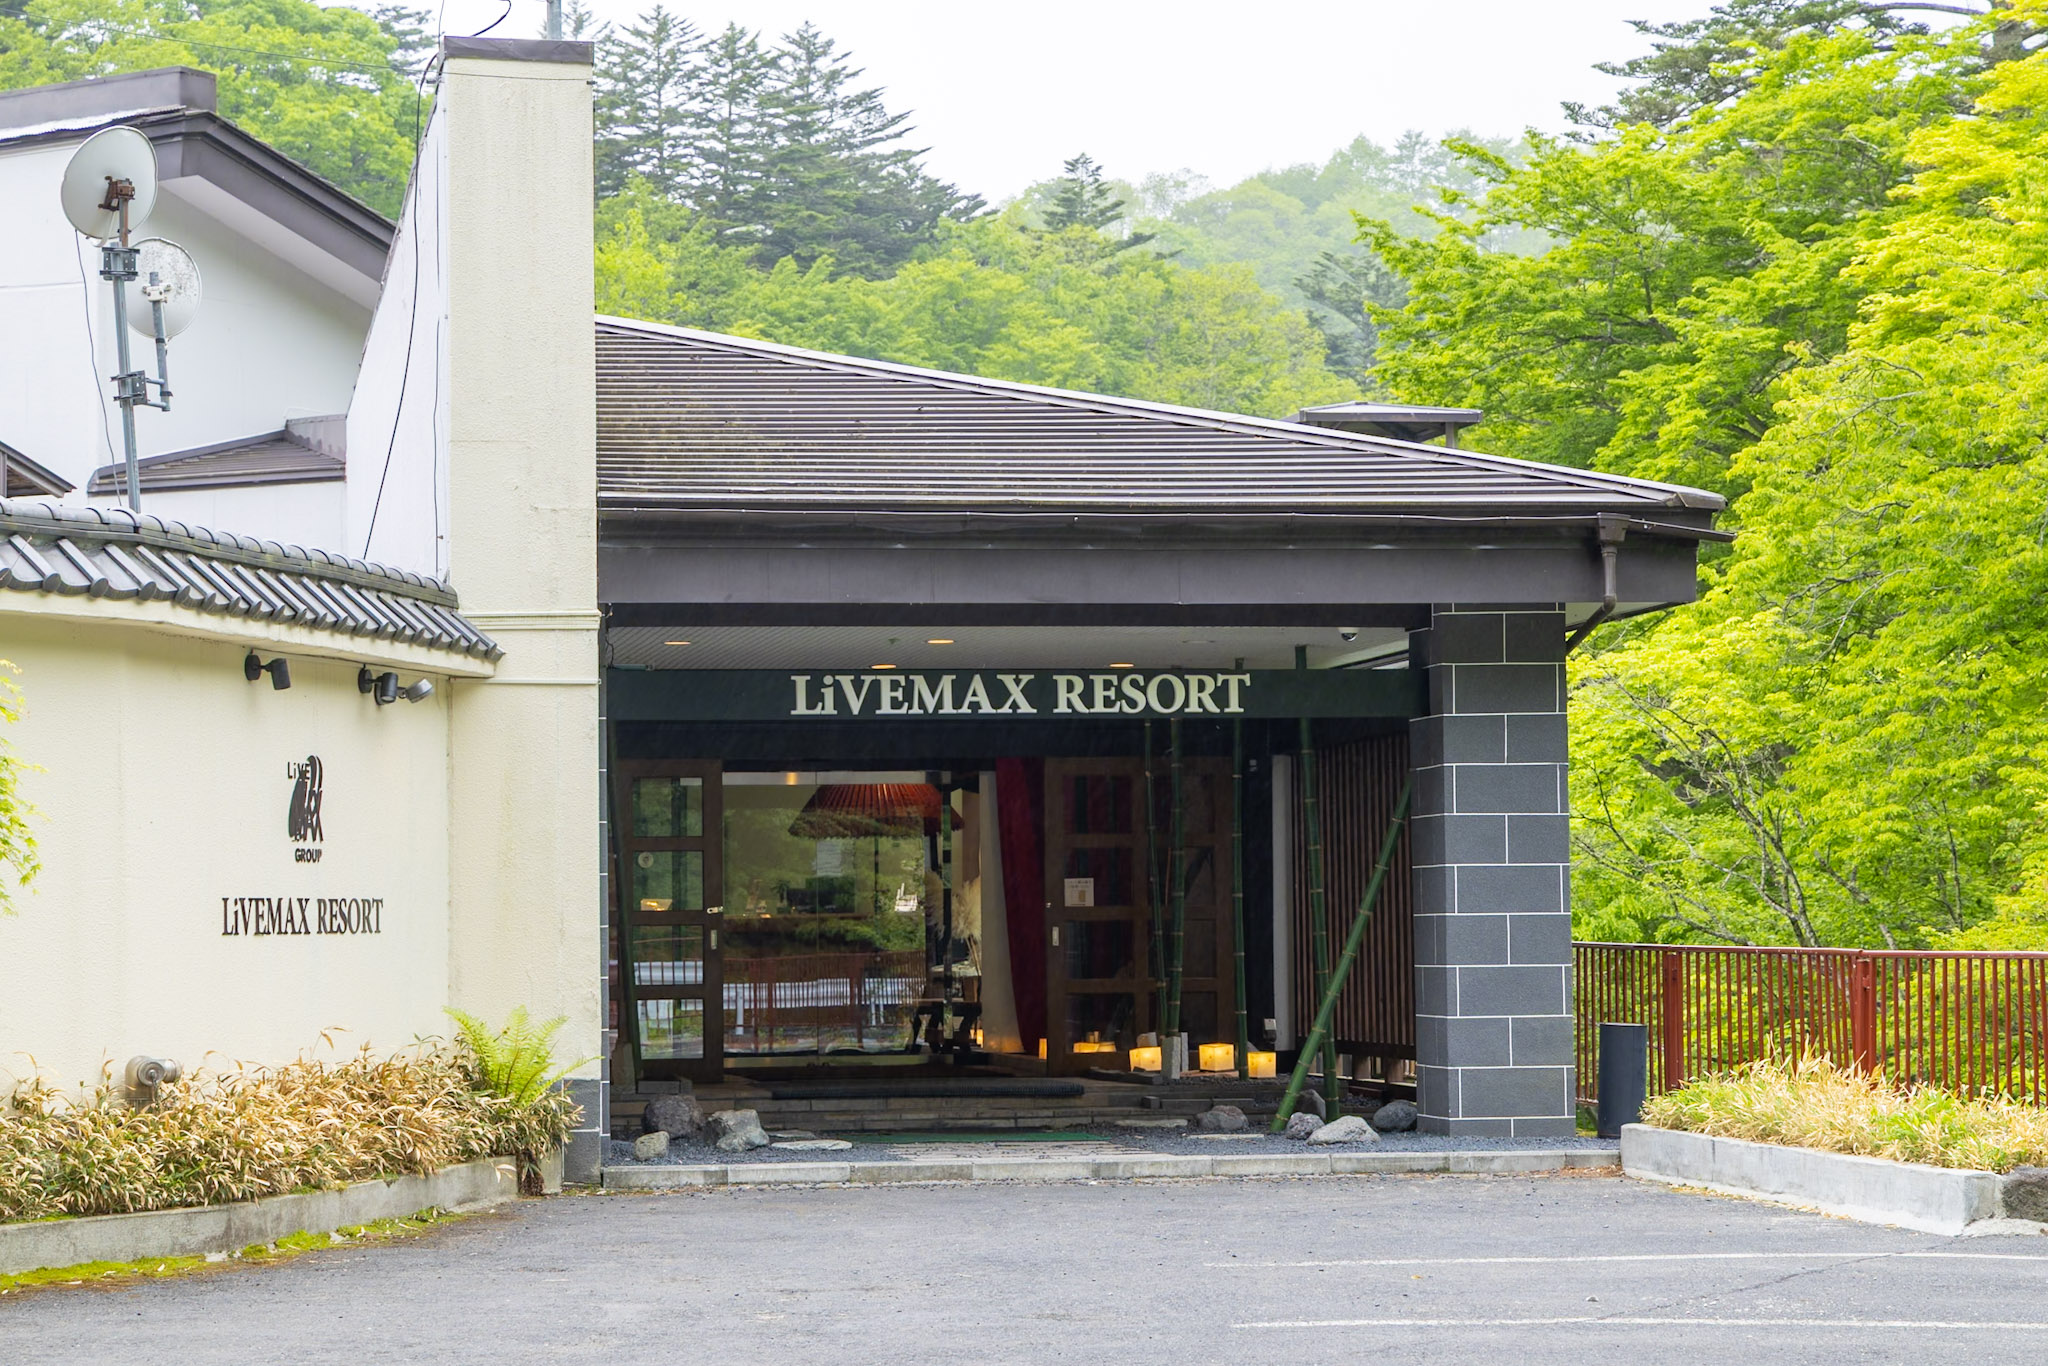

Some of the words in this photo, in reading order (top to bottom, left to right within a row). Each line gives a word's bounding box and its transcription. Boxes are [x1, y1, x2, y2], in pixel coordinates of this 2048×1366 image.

[790, 674, 1037, 715] LiVEMAX
[1052, 673, 1250, 713] RESORT
[294, 848, 322, 863] GROUP
[222, 897, 310, 935] LiVEMAX
[316, 898, 383, 934] RESORT
